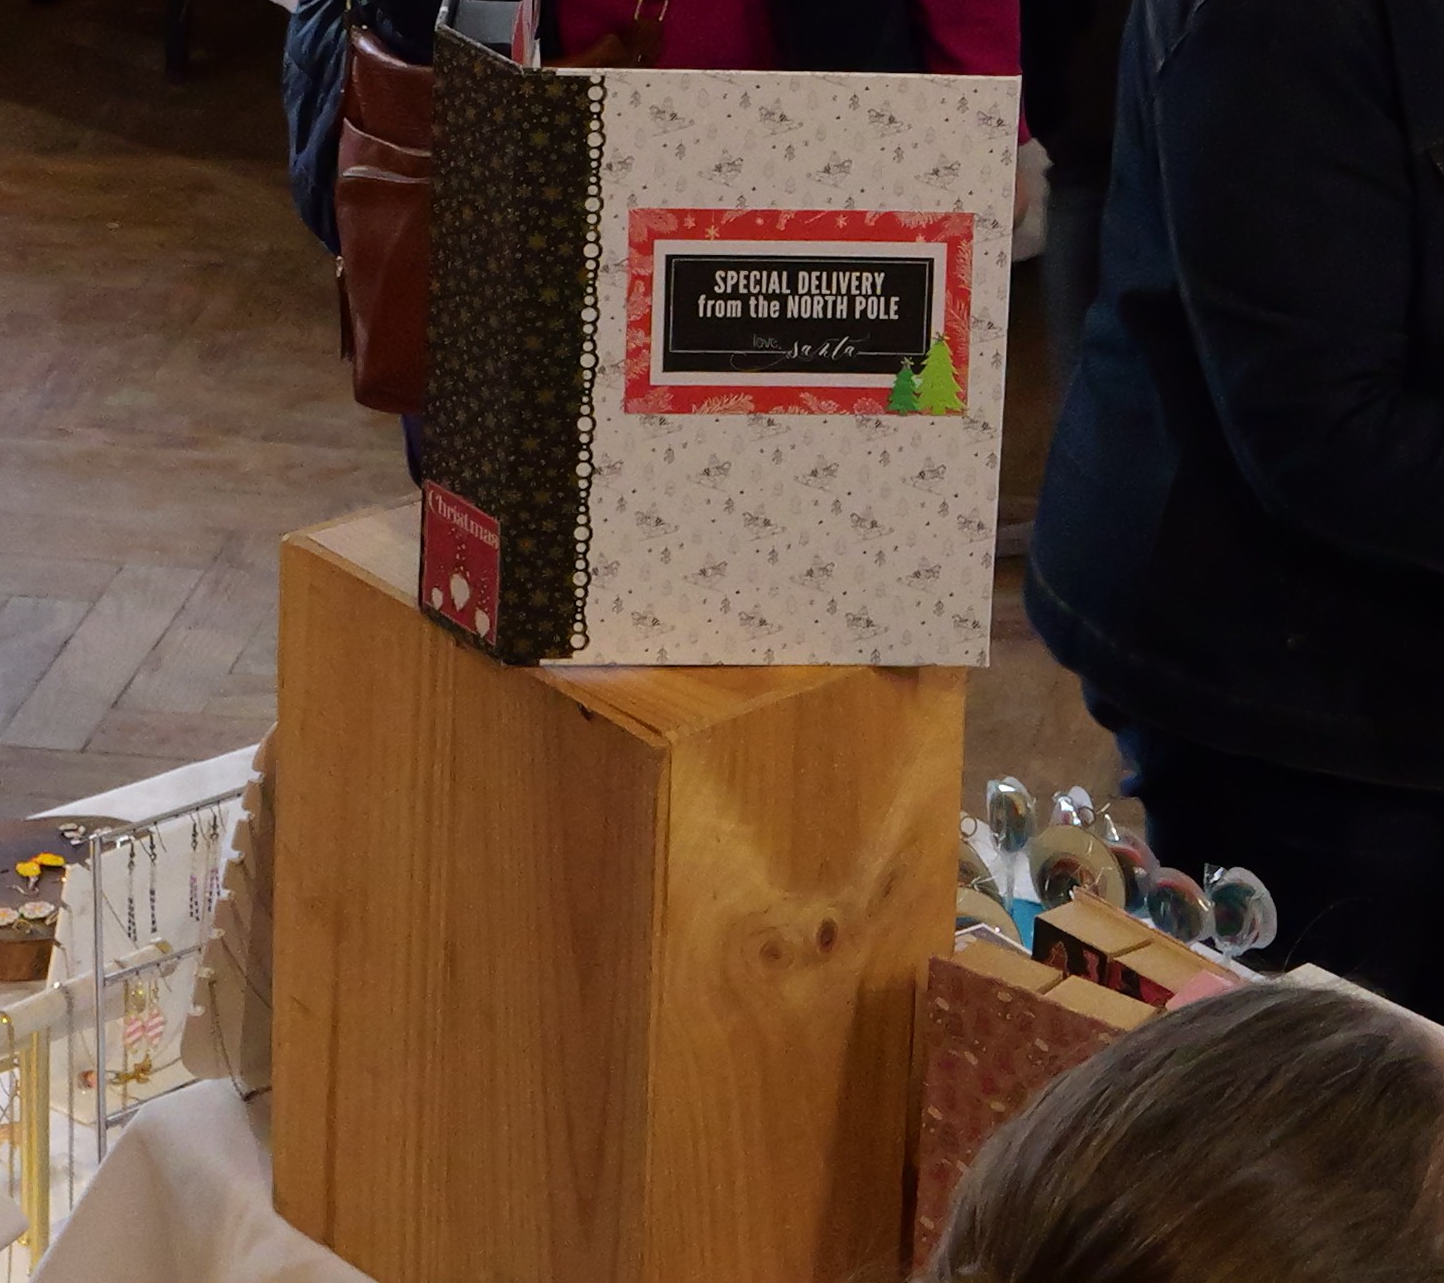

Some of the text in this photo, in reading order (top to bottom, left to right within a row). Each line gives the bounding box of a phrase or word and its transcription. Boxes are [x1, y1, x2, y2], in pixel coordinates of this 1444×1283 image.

[713, 270, 886, 295] SPECIAL DELIVERY
[698, 294, 900, 320] from the NORTH POLE
[428, 489, 501, 551] Christmas
